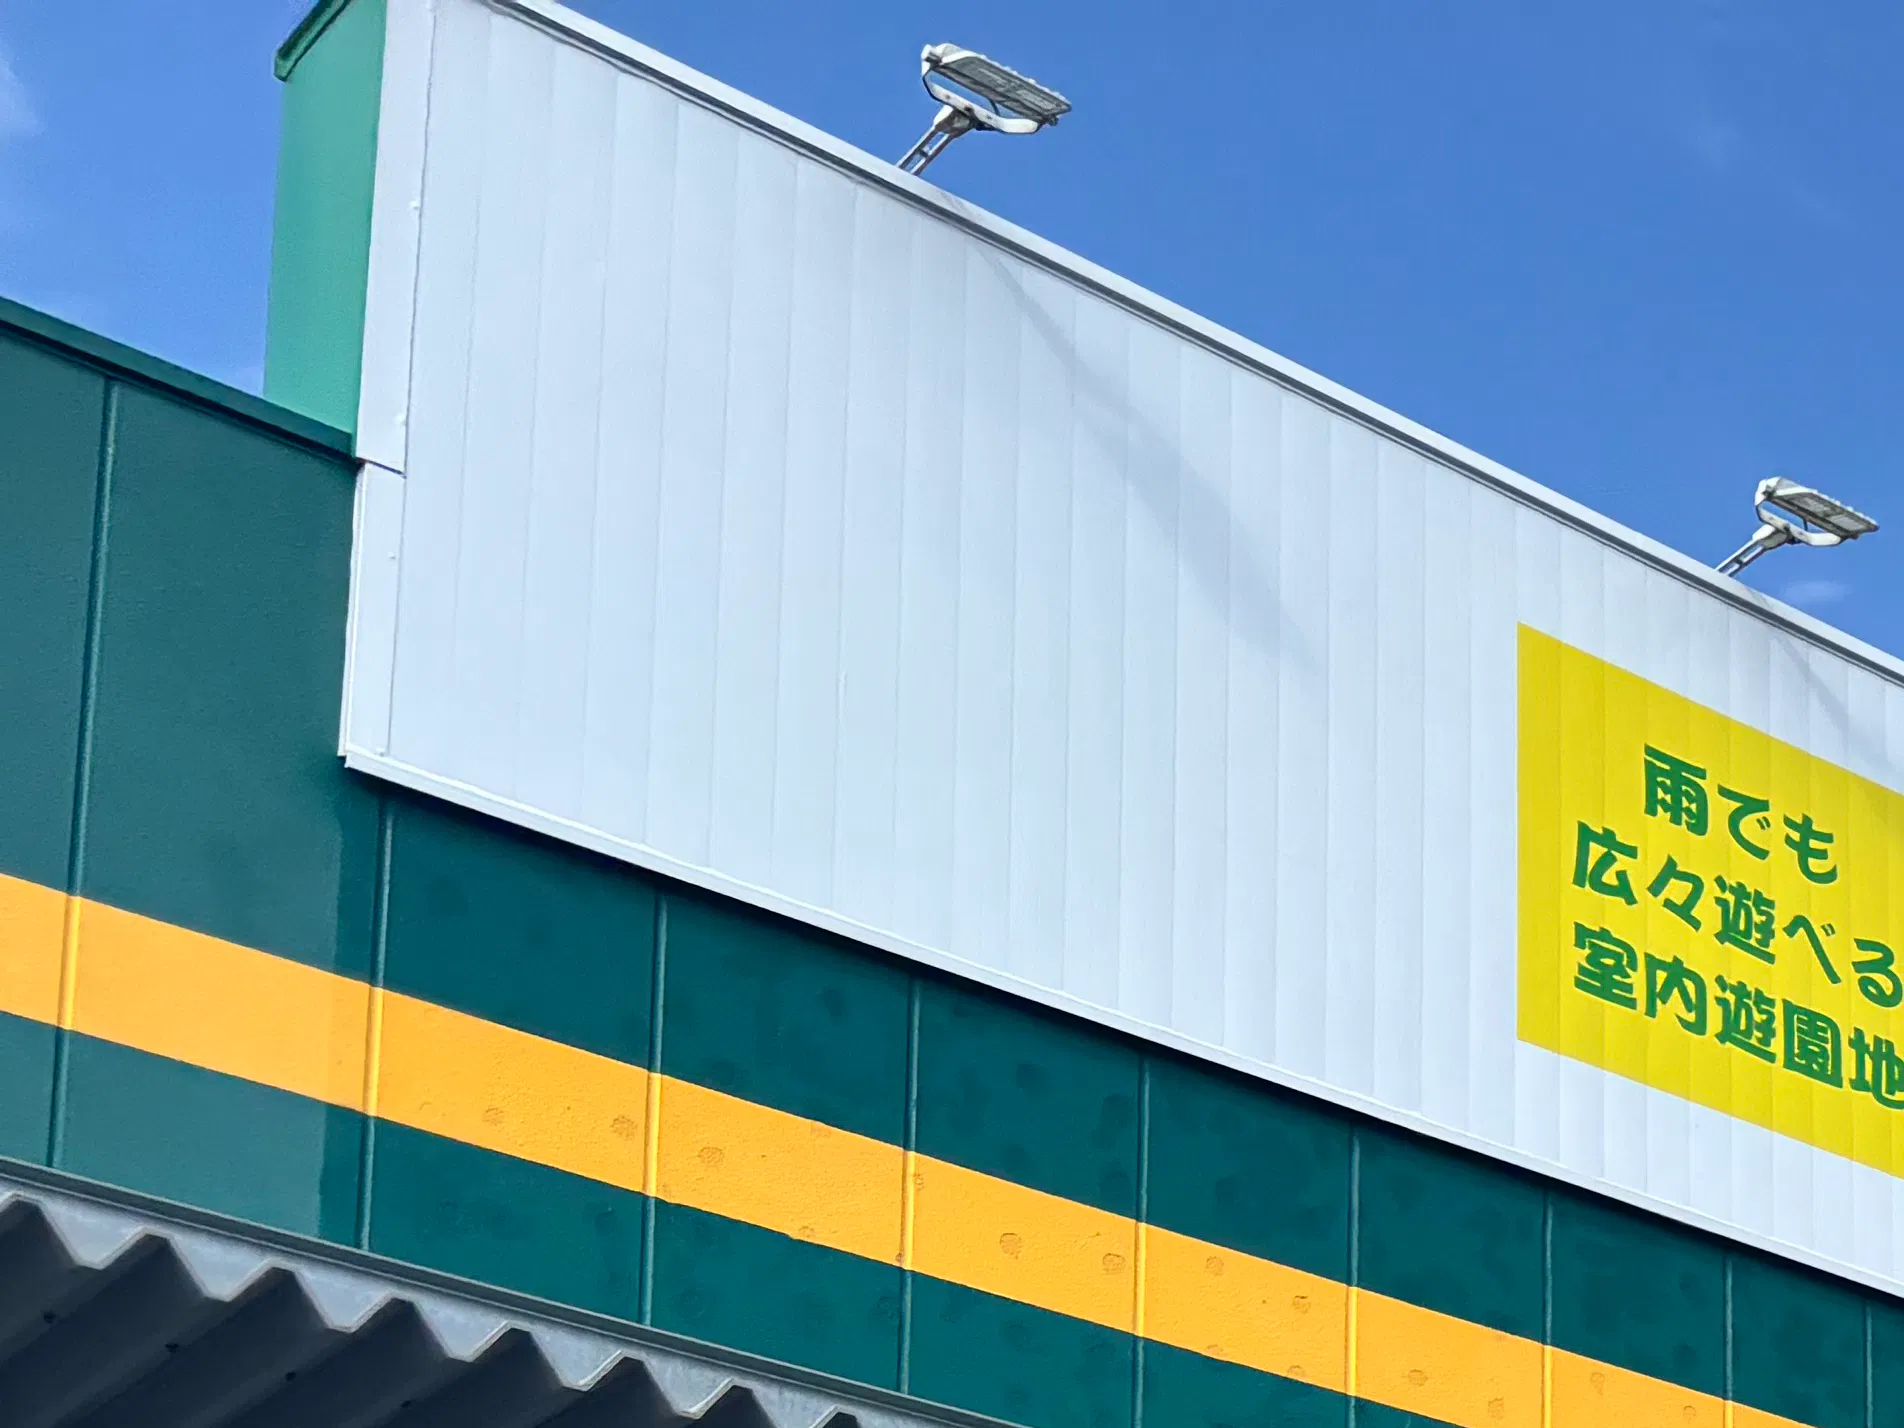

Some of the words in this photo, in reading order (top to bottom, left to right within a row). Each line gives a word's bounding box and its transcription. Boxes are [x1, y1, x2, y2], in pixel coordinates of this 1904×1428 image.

[1643, 743, 1839, 885] 雨でも
[1572, 822, 1904, 1009] 広々遊べる
